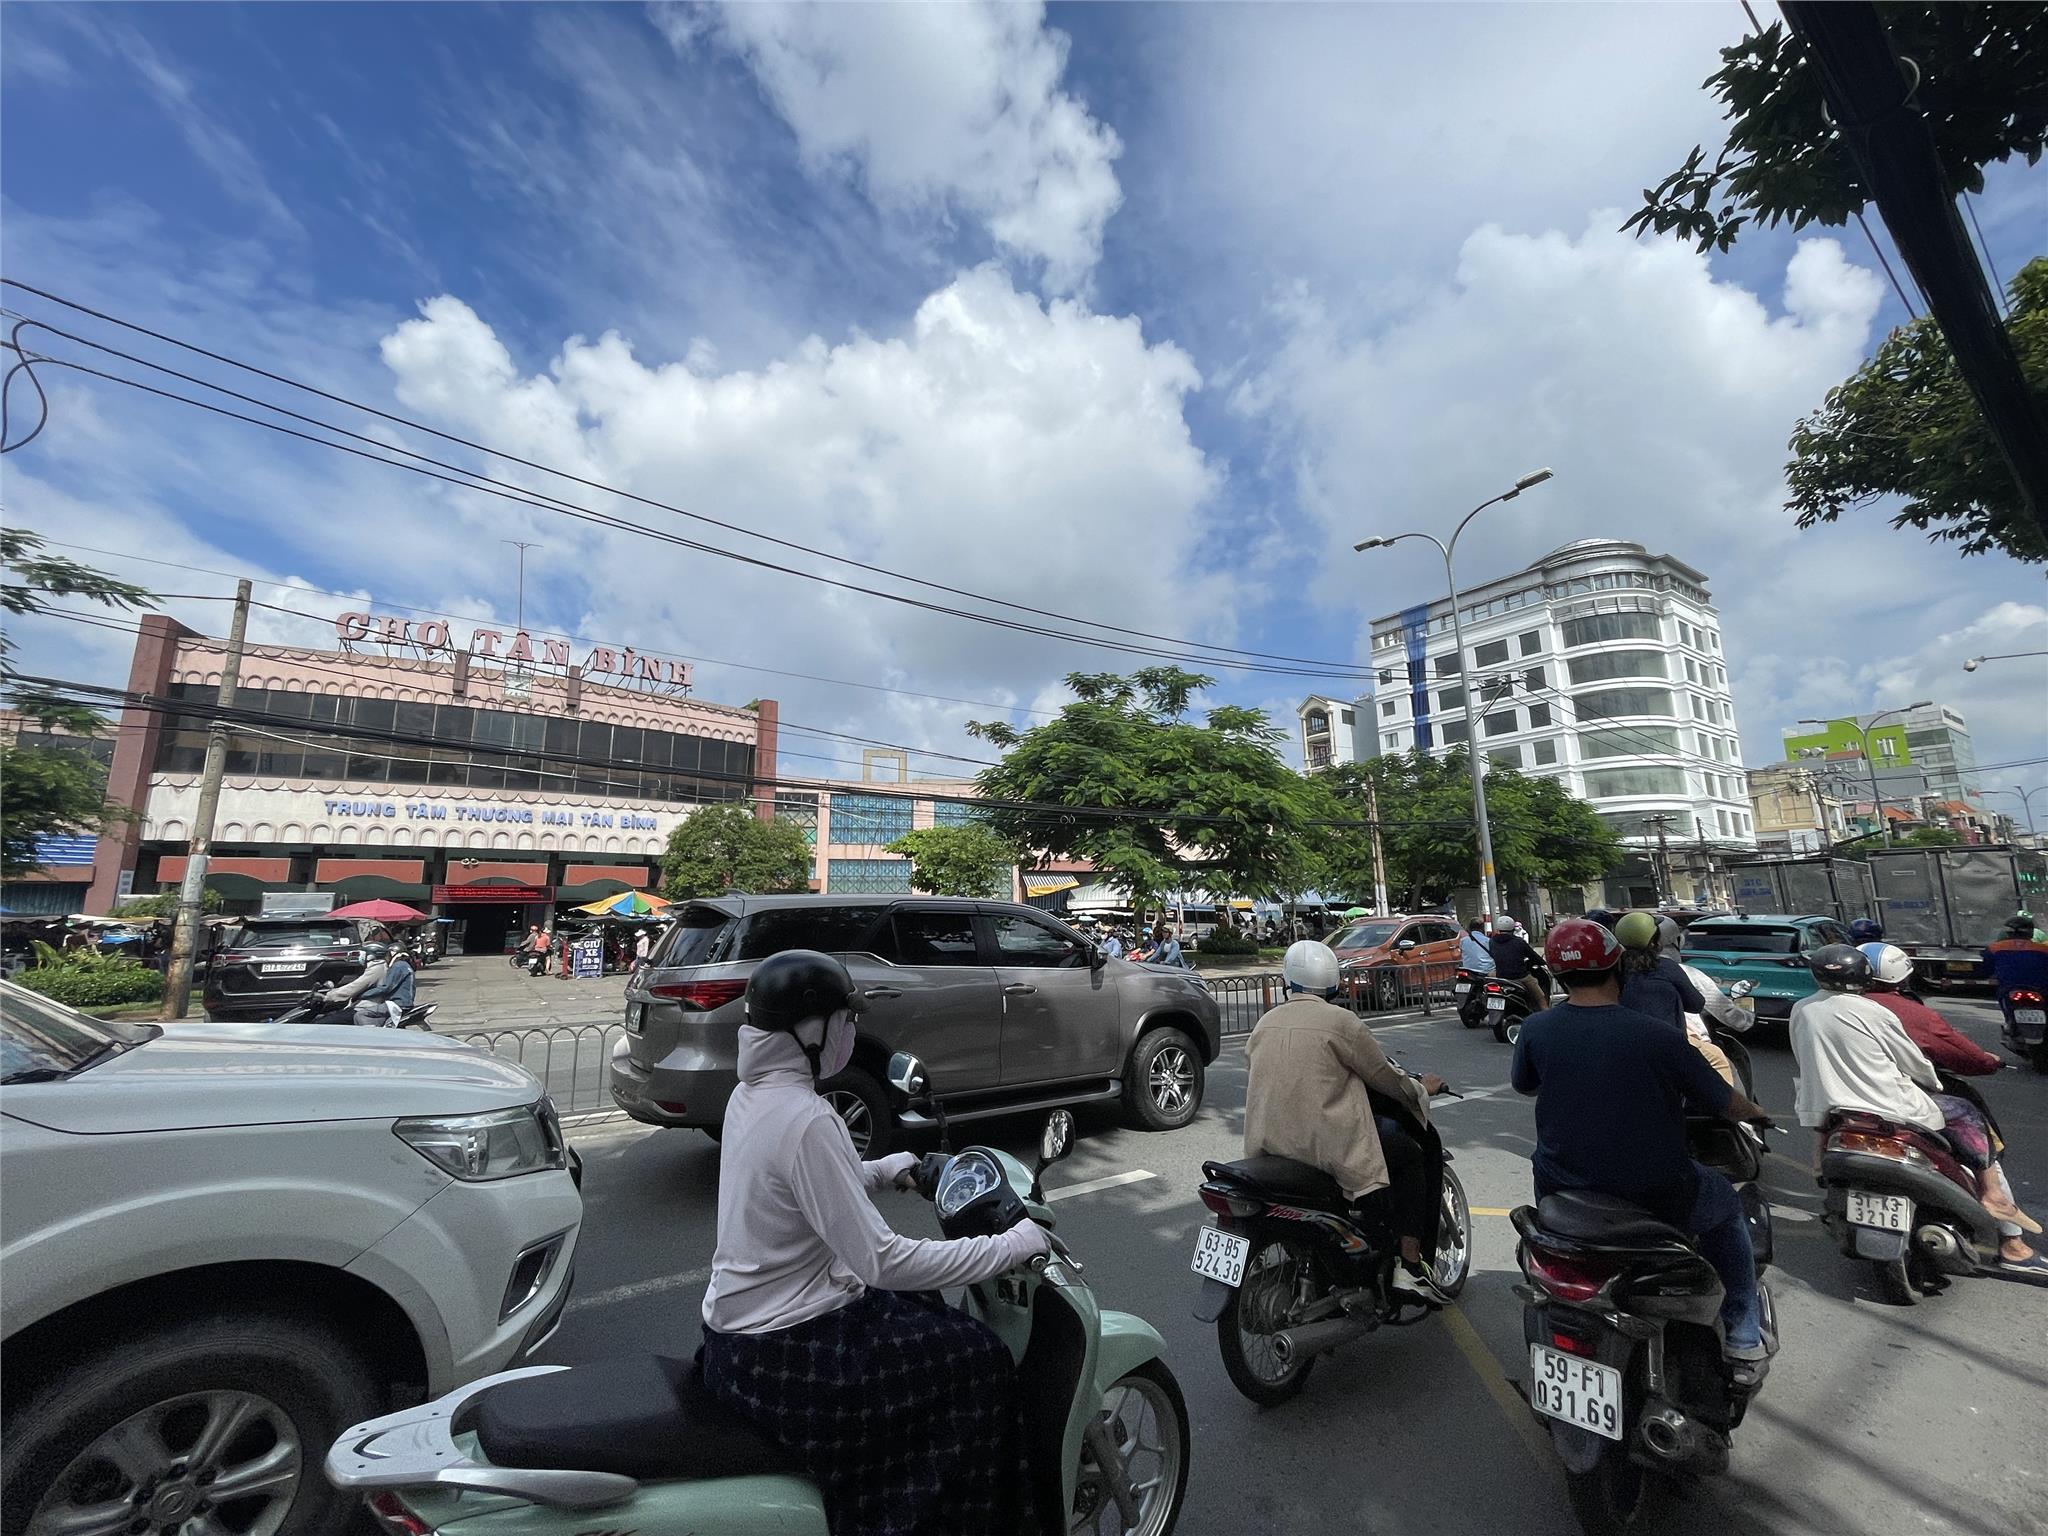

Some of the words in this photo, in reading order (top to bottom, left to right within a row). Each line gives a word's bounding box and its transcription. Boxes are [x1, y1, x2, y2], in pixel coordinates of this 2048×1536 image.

[335, 612, 449, 655] CHỢ
[476, 629, 570, 666] TÂN
[593, 646, 695, 686] BÌNH
[325, 800, 396, 818] TRUNG
[406, 803, 447, 820] TÂM
[455, 806, 533, 823] THƯƠNG
[541, 810, 574, 828] MẠI
[581, 812, 614, 829] TÂN
[620, 814, 657, 831] BÌNH
[585, 948, 599, 957] XE
[1855, 1207, 1898, 1228] 3216
[1195, 1250, 1241, 1282] 524.38
[1544, 1353, 1604, 1398] 59-F1
[1537, 1379, 1617, 1432] 031.69
